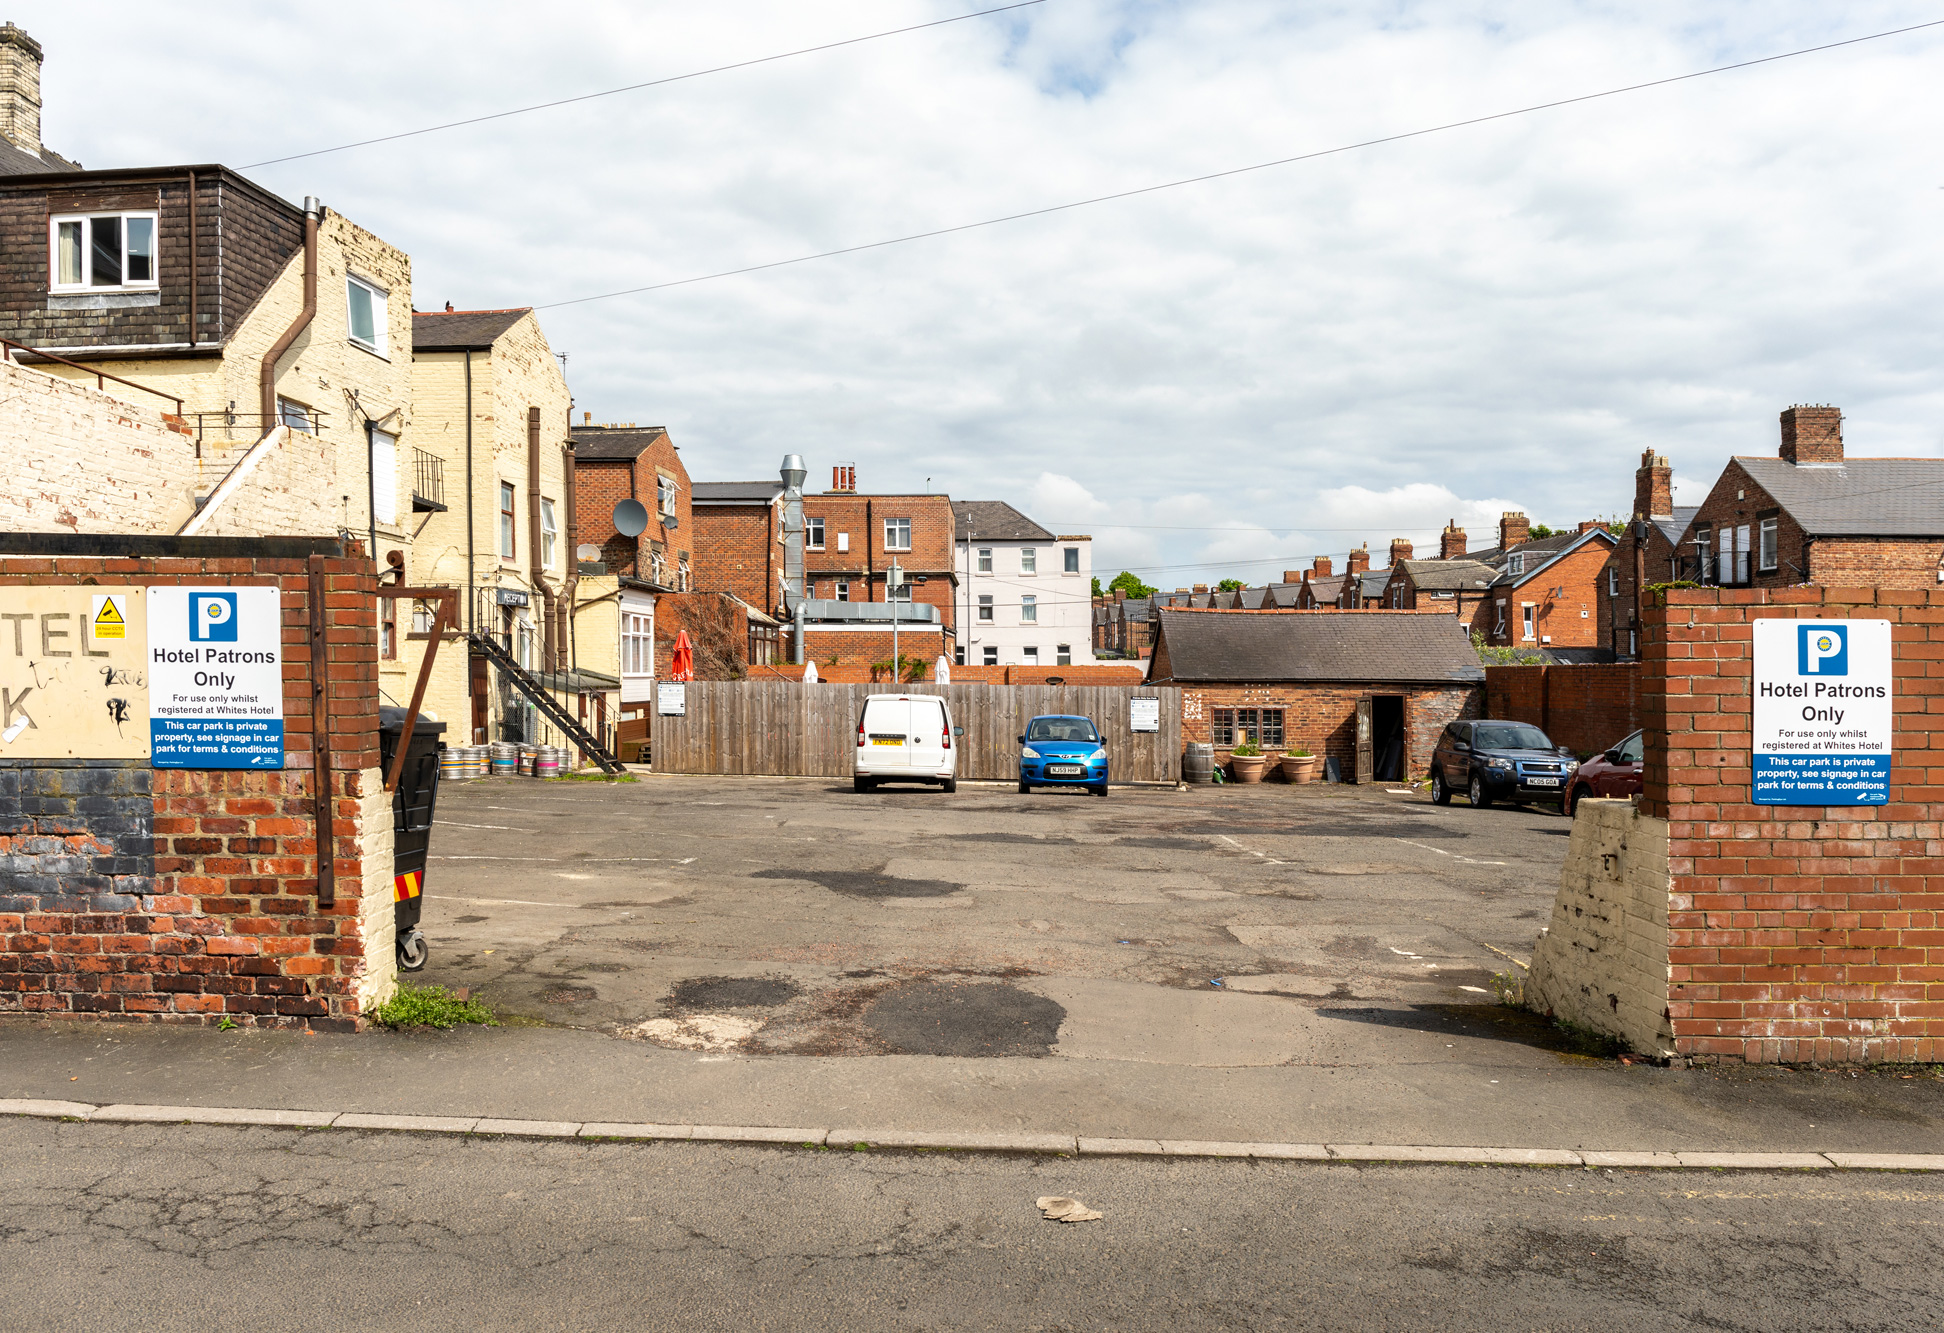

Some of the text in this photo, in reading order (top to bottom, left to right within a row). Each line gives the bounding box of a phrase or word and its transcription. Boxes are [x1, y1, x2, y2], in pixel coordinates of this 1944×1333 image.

[198, 597, 231, 638] P
[154, 648, 275, 663] Hotel Patrons
[1807, 630, 1841, 672] P
[195, 671, 236, 690] Only
[1761, 681, 1886, 697] Hotel Patrons
[210, 694, 229, 704] only
[231, 694, 259, 702] whilst
[2, 688, 38, 729] K
[159, 705, 203, 715] registered
[251, 706, 274, 714] Hotel
[1802, 705, 1845, 725] Only
[204, 722, 223, 731] park
[226, 722, 233, 730] is
[237, 722, 267, 731] private
[155, 734, 194, 743] property,
[215, 734, 251, 743] signage
[1779, 729, 1795, 737] For
[1817, 729, 1837, 739] only
[1840, 729, 1867, 737] whilst
[156, 745, 175, 753] park
[221, 745, 228, 753] &
[231, 745, 278, 753] conditions
[1763, 741, 1810, 750] registered
[1824, 741, 1856, 749] Whites
[1859, 741, 1883, 749] Hotel
[1769, 757, 1789, 765] This
[1810, 758, 1830, 767] park
[1844, 758, 1875, 767] private
[1757, 770, 1799, 779] property,
[1821, 770, 1858, 779] signage
[1758, 781, 1778, 790] park
[1781, 781, 1795, 789] for
[1827, 781, 1833, 789] &
